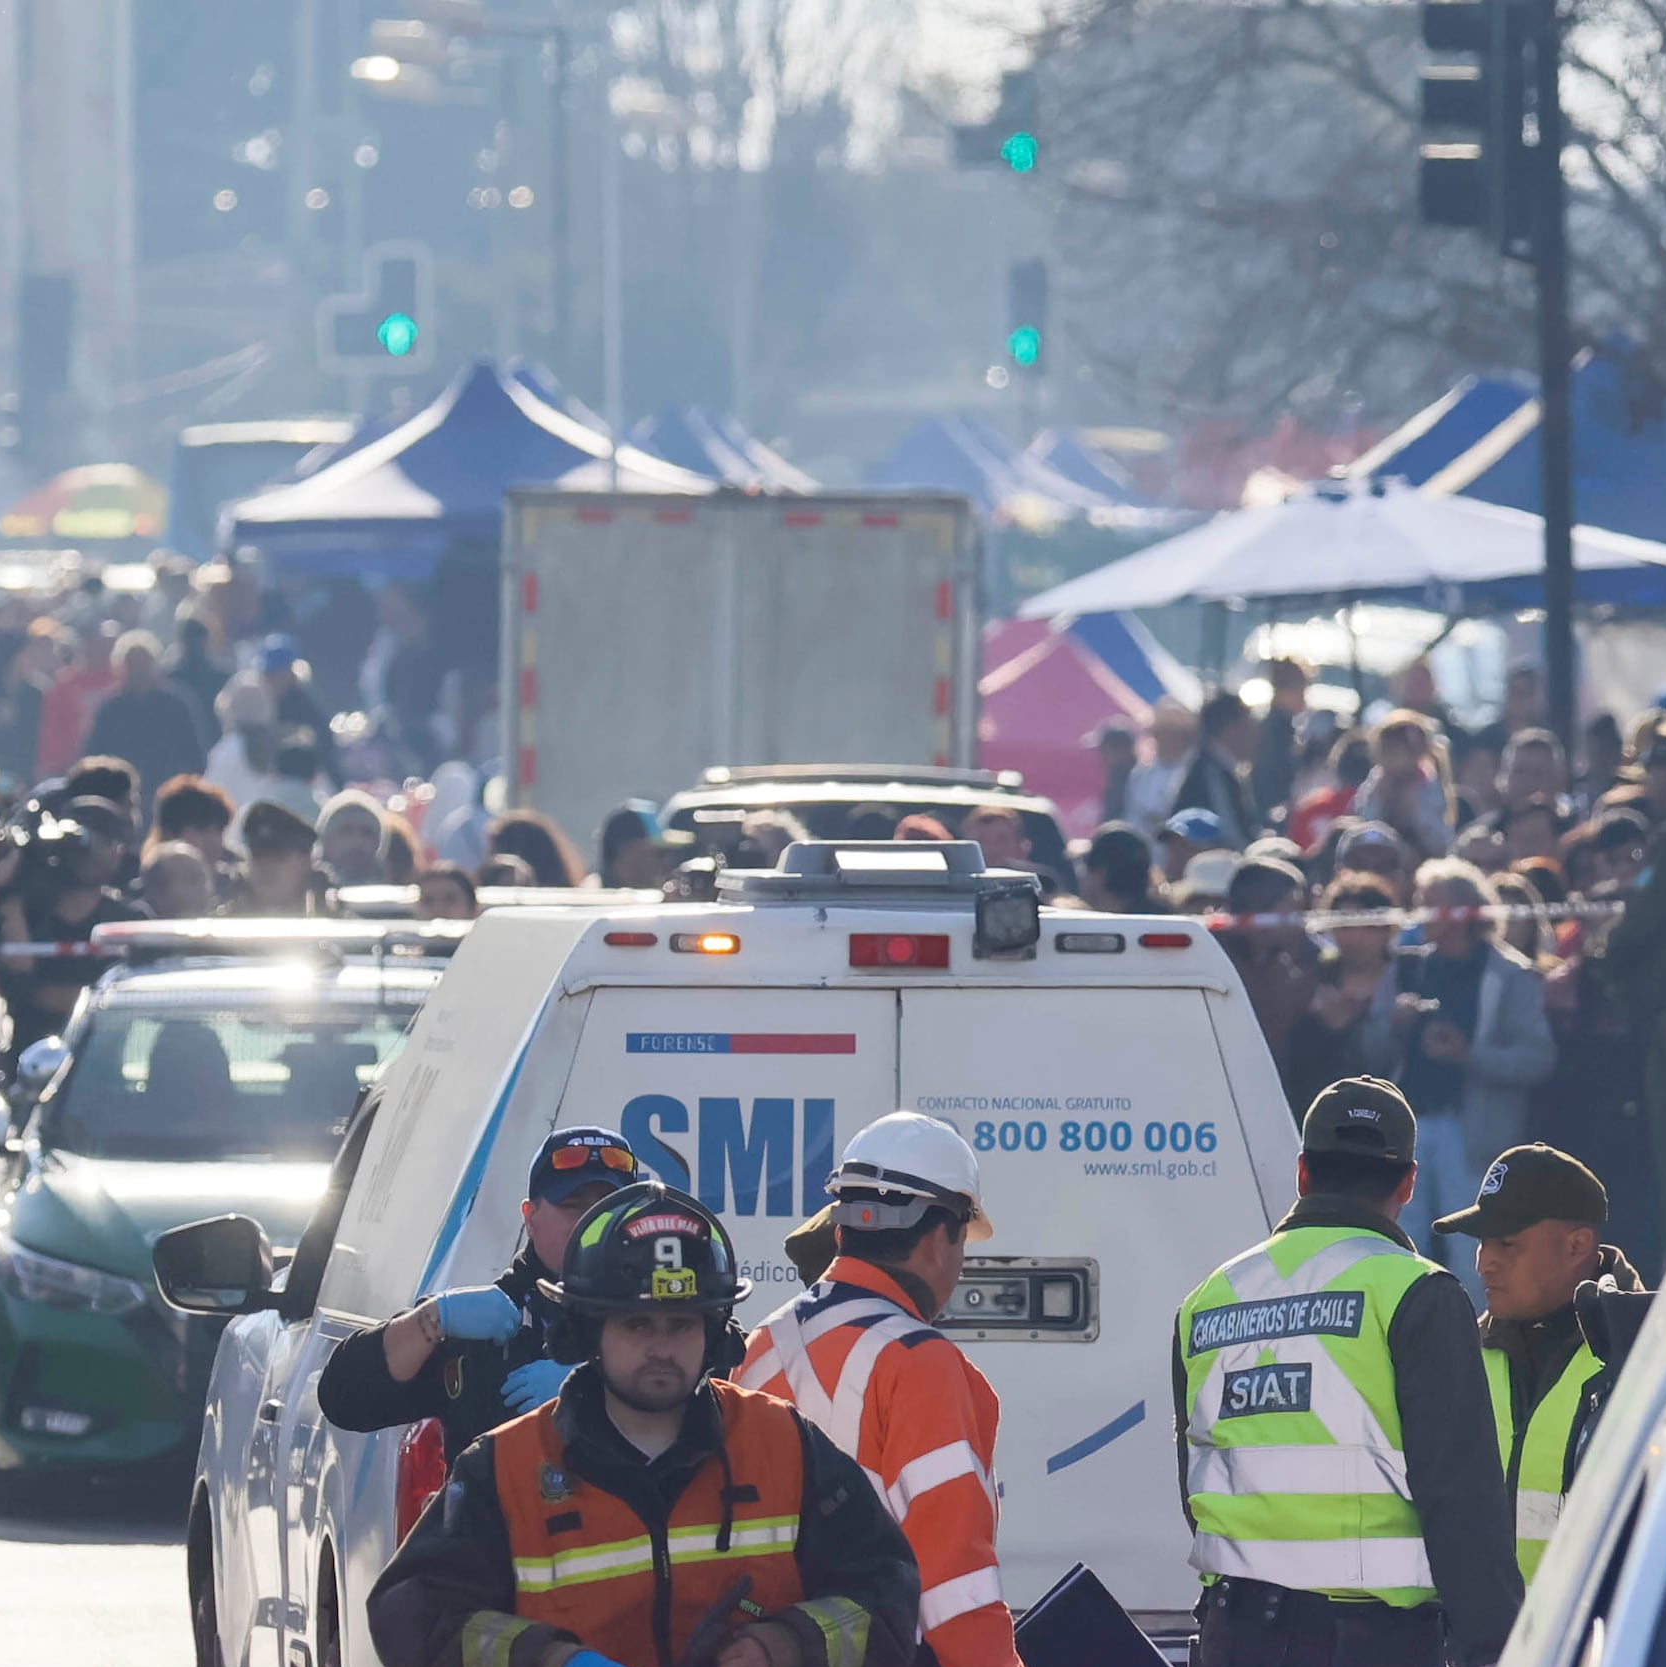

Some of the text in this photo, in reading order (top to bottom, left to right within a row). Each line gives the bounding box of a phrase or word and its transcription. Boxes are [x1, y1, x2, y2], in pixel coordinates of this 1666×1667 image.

[917, 1096, 1132, 1111] CONTACTO NACIONAL GRATUITO
[973, 1121, 1217, 1153] 800 800 006
[1083, 1159, 1217, 1180] www.sml.gob.cl
[657, 1218, 676, 1230] DEL
[654, 1236, 682, 1269] 9
[735, 1260, 796, 1283] édico
[1193, 1298, 1357, 1349] CARABINEROS DE CHILE
[1229, 1371, 1307, 1411] SIAT
